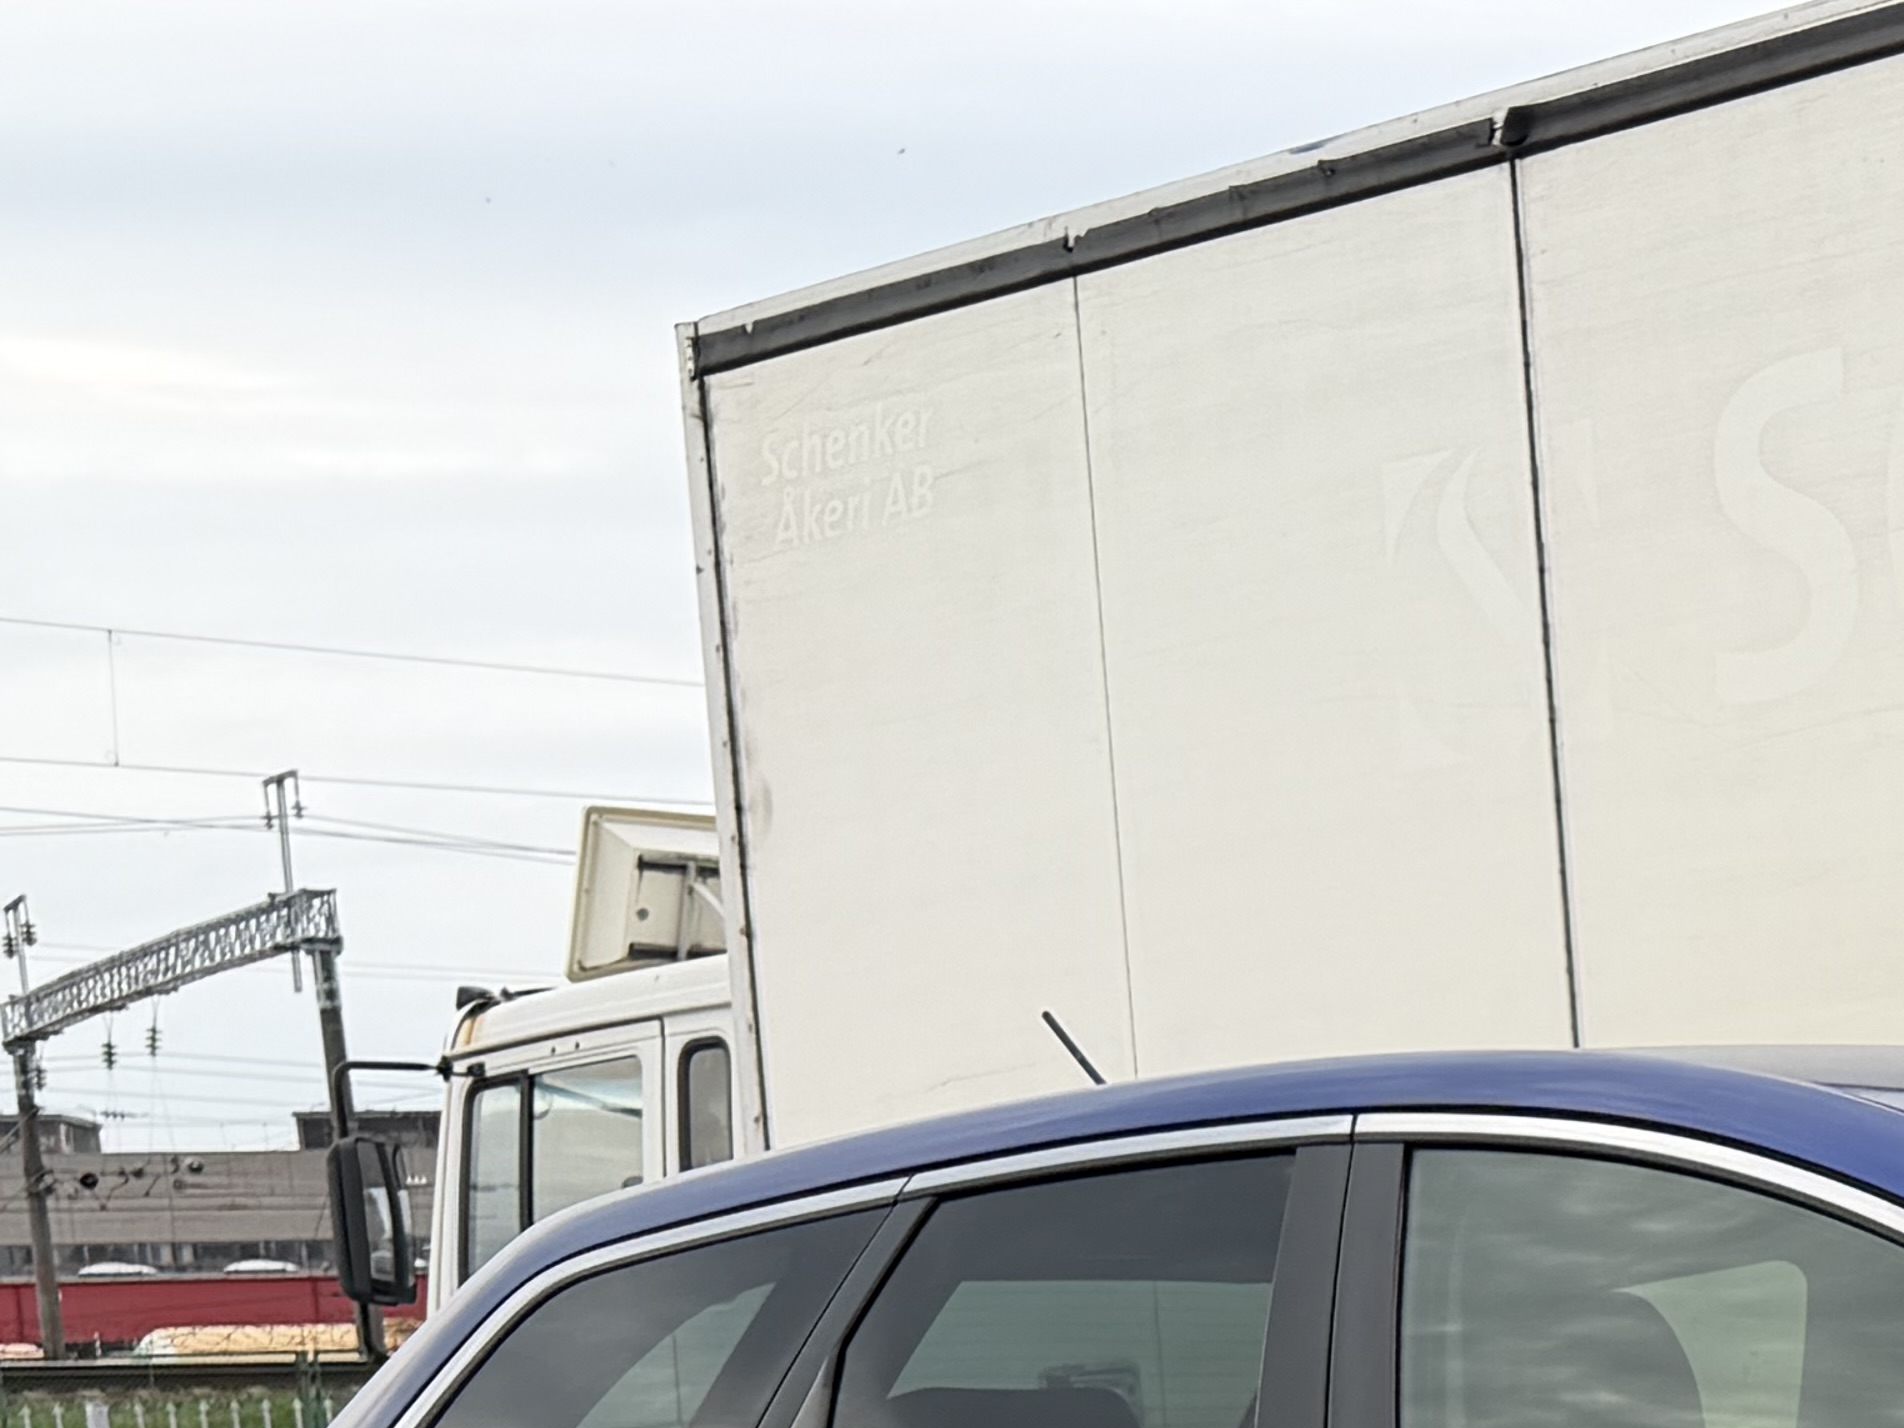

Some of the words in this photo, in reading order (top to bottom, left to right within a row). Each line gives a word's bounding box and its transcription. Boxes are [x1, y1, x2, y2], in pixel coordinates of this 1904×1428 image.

[760, 401, 935, 488] Schenker
[774, 474, 873, 548] Åkeri
[882, 462, 934, 528] AB
